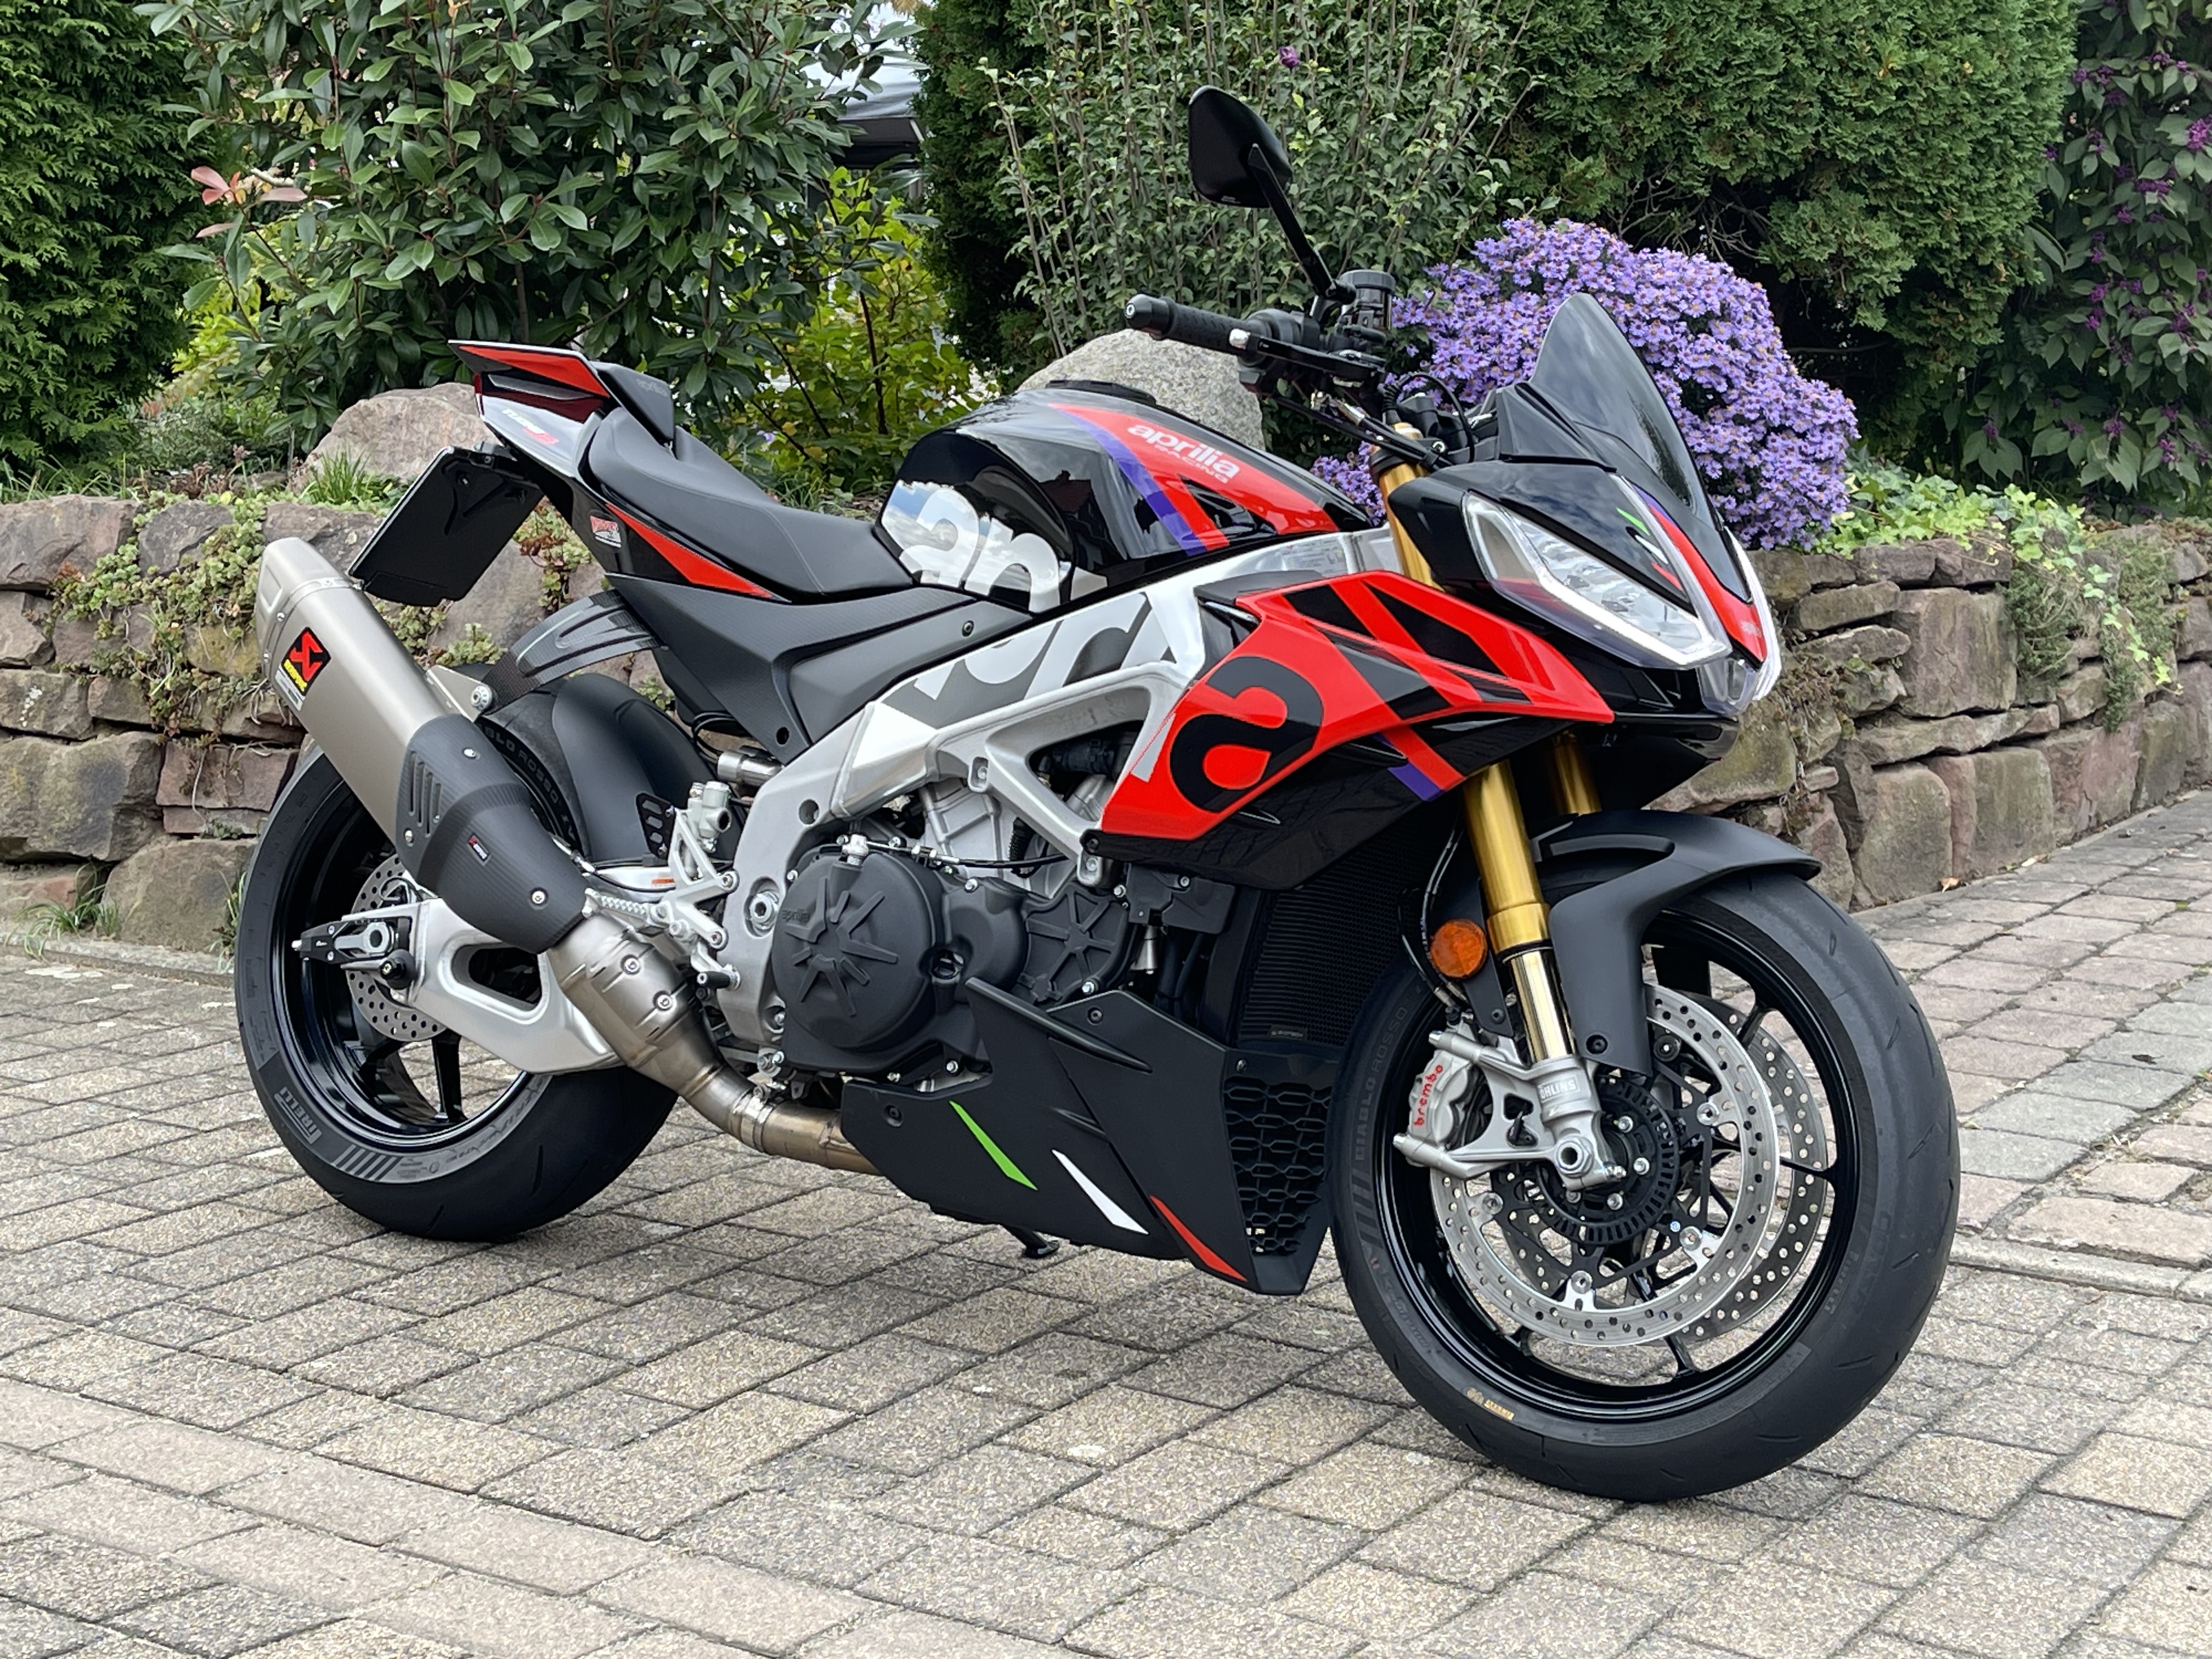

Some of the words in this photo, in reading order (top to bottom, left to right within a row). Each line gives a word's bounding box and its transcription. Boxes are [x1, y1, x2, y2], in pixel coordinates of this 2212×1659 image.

[1128, 425, 1240, 479] aprilia
[1154, 444, 1229, 484] RACING
[518, 749, 559, 804] ROSSO
[1354, 1076, 1376, 1161] DIABLO
[1371, 1006, 1408, 1074] ROSSO
[1413, 1064, 1443, 1126] brembo
[274, 1086, 323, 1145] PIRELLI
